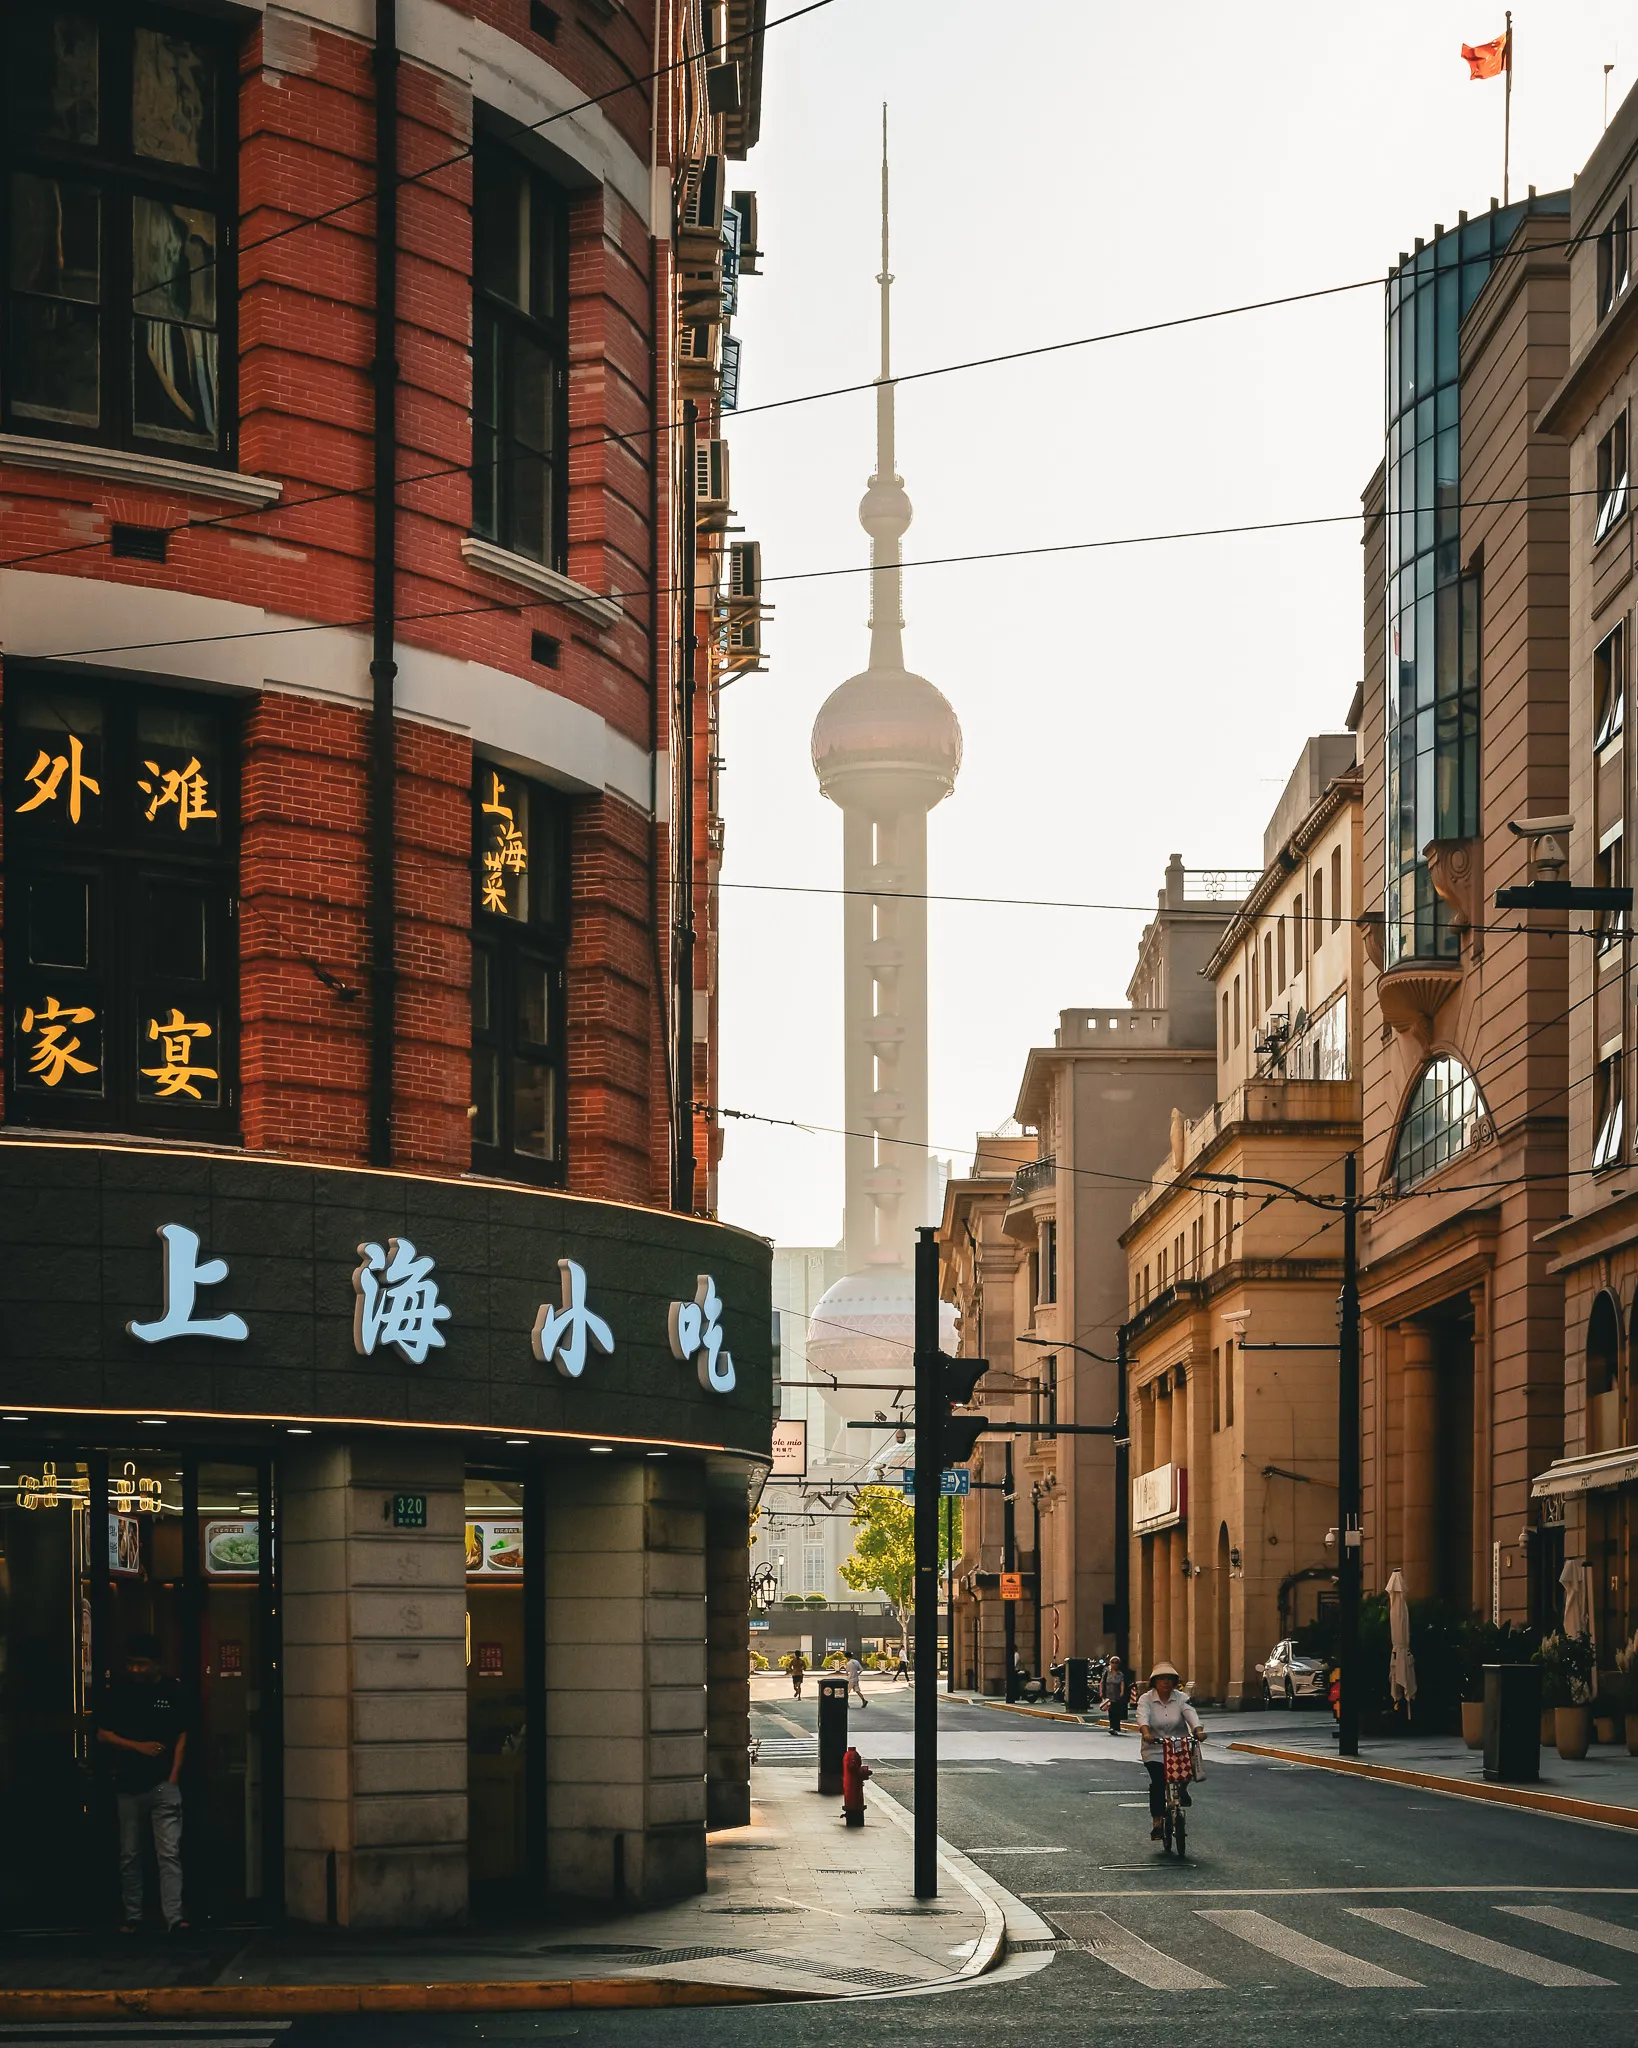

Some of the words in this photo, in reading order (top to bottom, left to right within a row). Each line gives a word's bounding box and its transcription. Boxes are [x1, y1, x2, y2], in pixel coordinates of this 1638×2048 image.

[16, 735, 218, 831] 外滩
[481, 771, 528, 914] 上海菜
[21, 996, 219, 1100] 家宴
[127, 1222, 737, 1393] 上海小吃
[398, 1497, 422, 1514] 320
